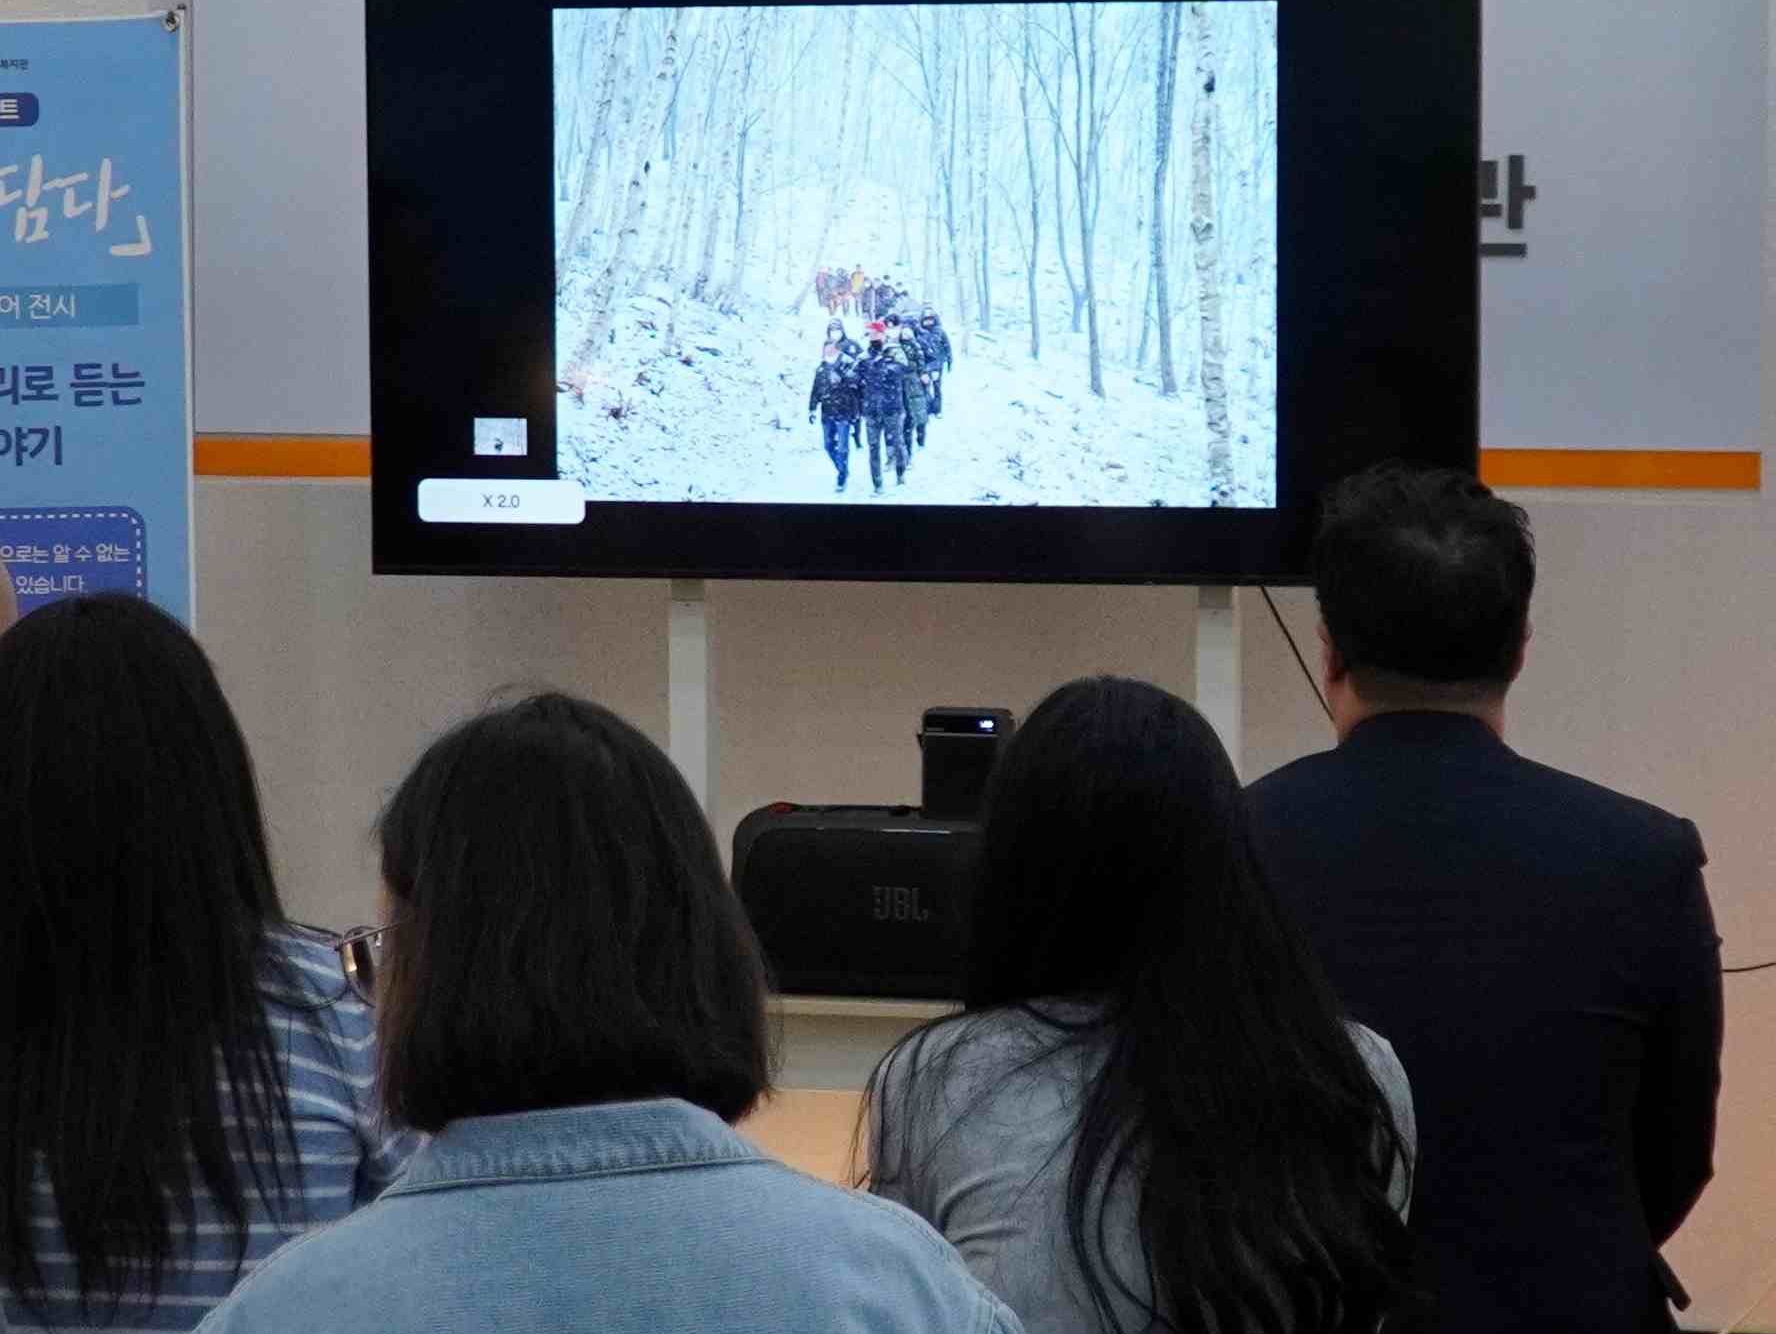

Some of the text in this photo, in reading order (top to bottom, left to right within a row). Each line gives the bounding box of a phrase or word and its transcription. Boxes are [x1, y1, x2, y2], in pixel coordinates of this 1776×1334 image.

[28, 294, 76, 319] 전시
[69, 362, 146, 407] 듣는
[496, 494, 520, 508] 2.0
[0, 542, 131, 564] 으로는 알 수 없는
